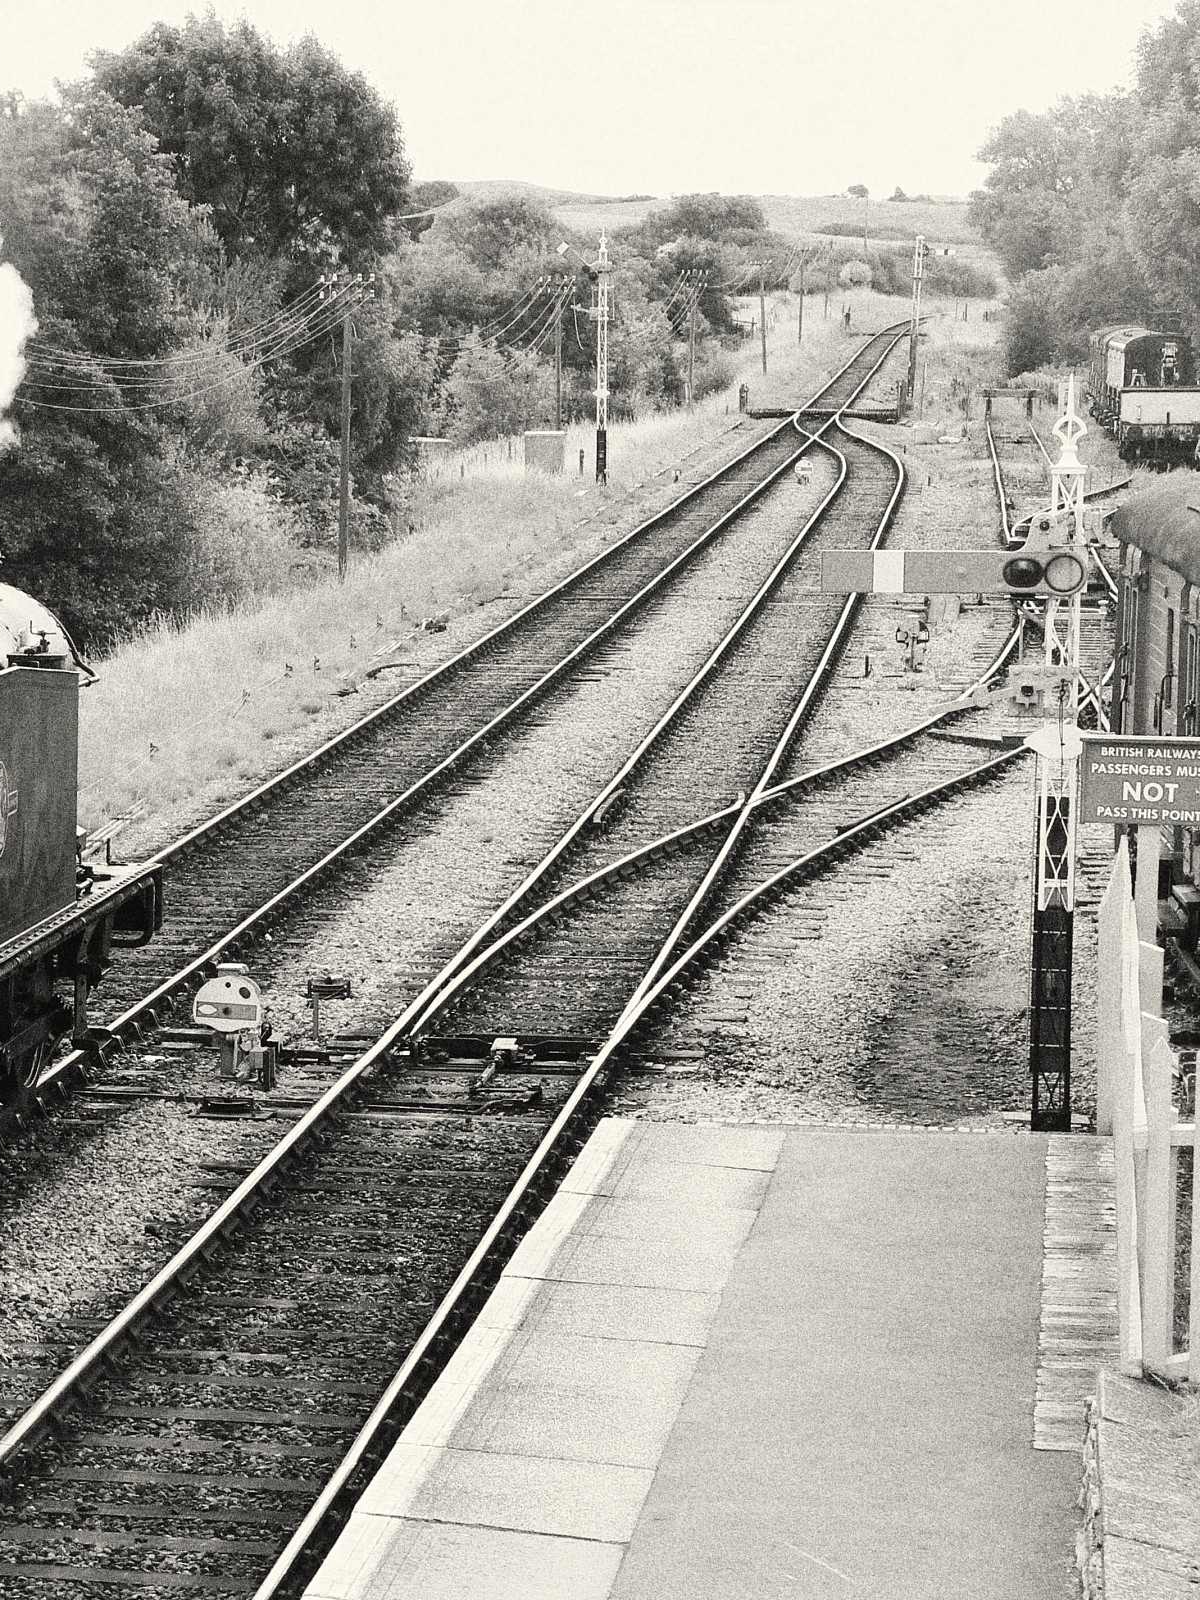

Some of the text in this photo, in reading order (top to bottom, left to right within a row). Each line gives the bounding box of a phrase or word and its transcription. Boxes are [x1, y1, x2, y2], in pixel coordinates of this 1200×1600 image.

[1101, 747, 1143, 757] BRITISH
[1091, 763, 1172, 776] PASSENGERS
[1122, 781, 1179, 803] NOT
[1097, 806, 1200, 821] PASS THIS POINT
